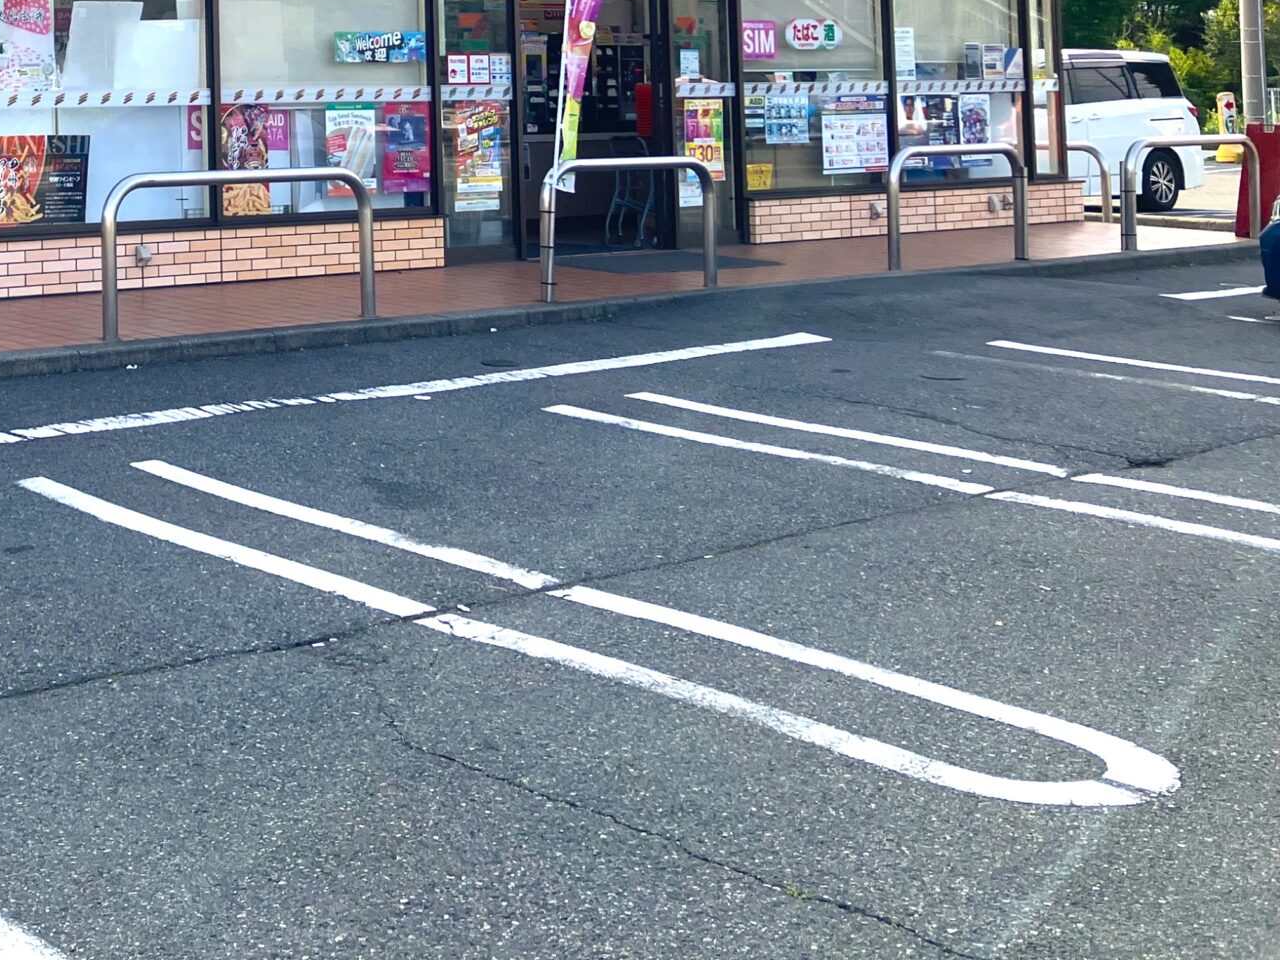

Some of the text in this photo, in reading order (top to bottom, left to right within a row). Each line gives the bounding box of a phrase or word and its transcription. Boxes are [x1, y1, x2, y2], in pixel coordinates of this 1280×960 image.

[355, 31, 402, 51] Welcome
[743, 29, 775, 54] SIM
[792, 23, 819, 41] たばこ
[823, 24, 835, 41] 酒
